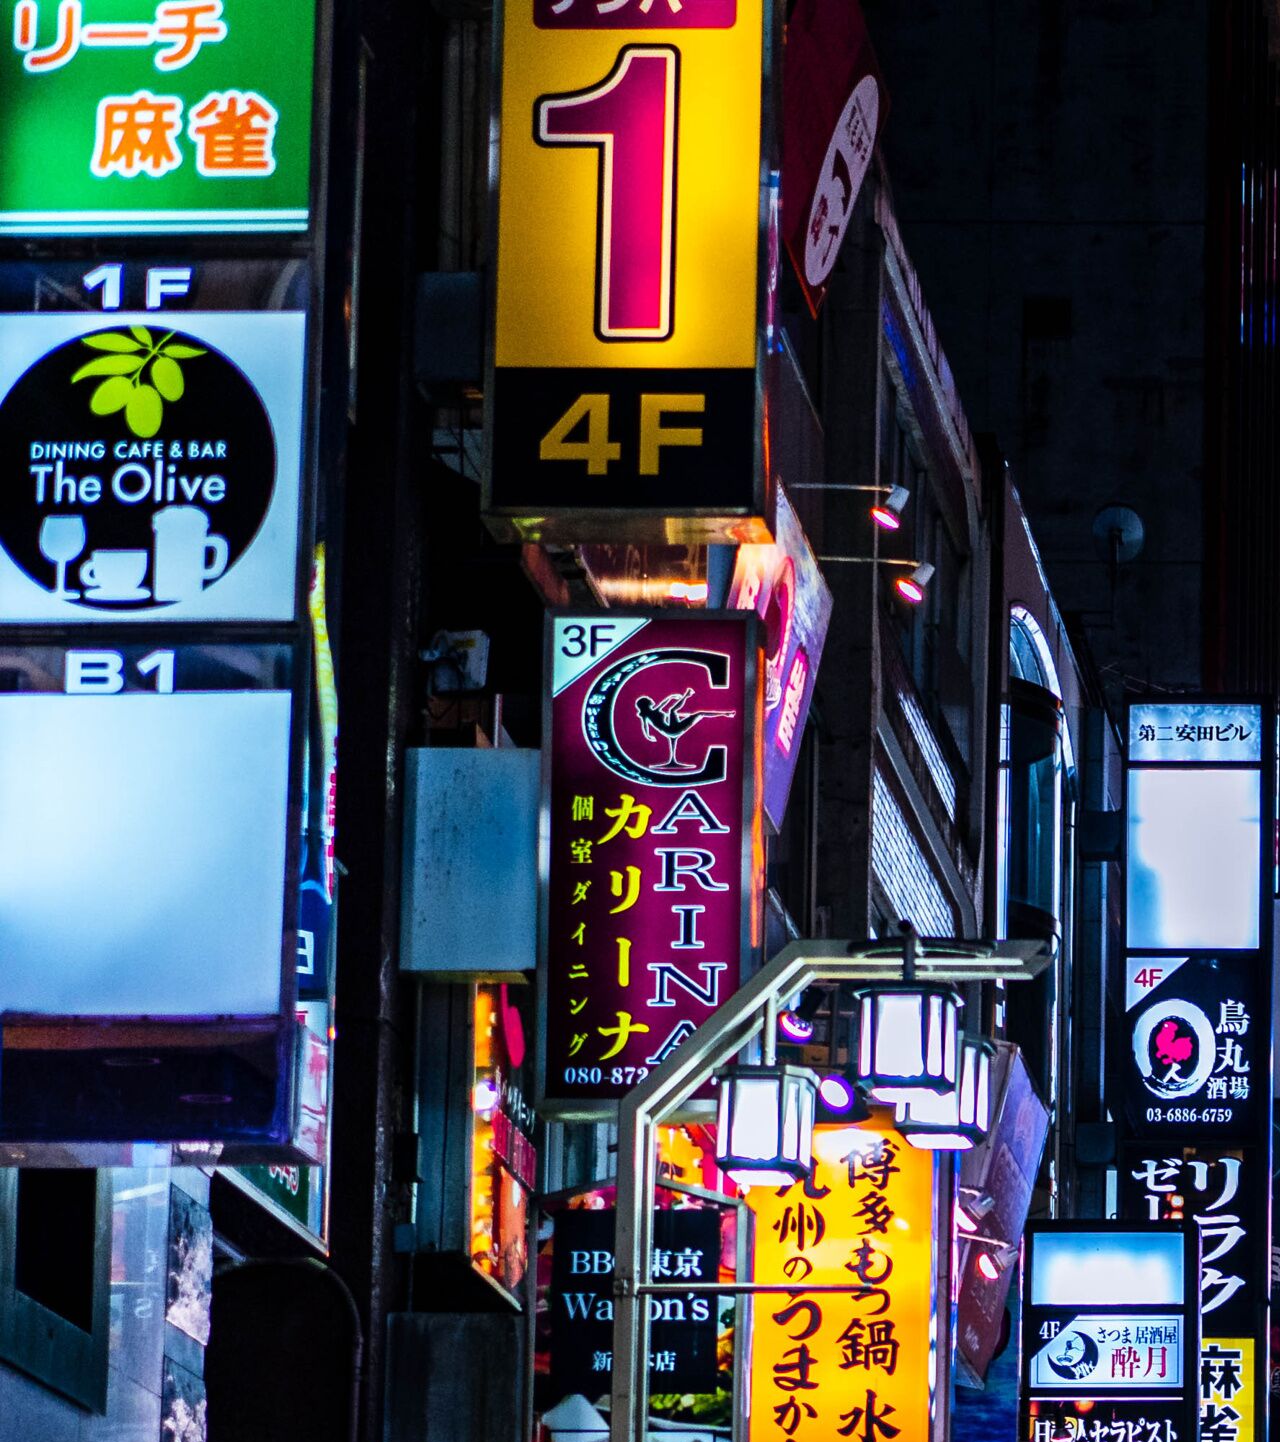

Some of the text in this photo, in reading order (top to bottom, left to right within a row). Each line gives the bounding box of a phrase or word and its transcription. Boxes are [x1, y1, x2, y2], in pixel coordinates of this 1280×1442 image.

[12, 0, 227, 71] リーチ
[92, 90, 278, 177] 麻雀
[534, 44, 680, 342] 1
[82, 263, 193, 311] 1F
[30, 442, 227, 459] DINING CAFE & BAR
[540, 394, 706, 475] 4F
[30, 460, 227, 503] The Olive
[561, 624, 616, 658] 3F
[64, 650, 176, 694] B1
[1138, 724, 1252, 742] 第二安田ビル
[569, 795, 594, 1058] 個室ダイニング
[598, 794, 653, 1062] カリーナ
[1134, 969, 1162, 987] 4F
[1207, 1076, 1250, 1099] 酒場
[1147, 1108, 1232, 1122] 03-6886-6759
[838, 1139, 901, 1377] 博多もつ鍋
[1039, 1321, 1060, 1339] 4F
[1097, 1326, 1177, 1345] さつま 居酒屋
[1110, 1347, 1168, 1379] 酔月
